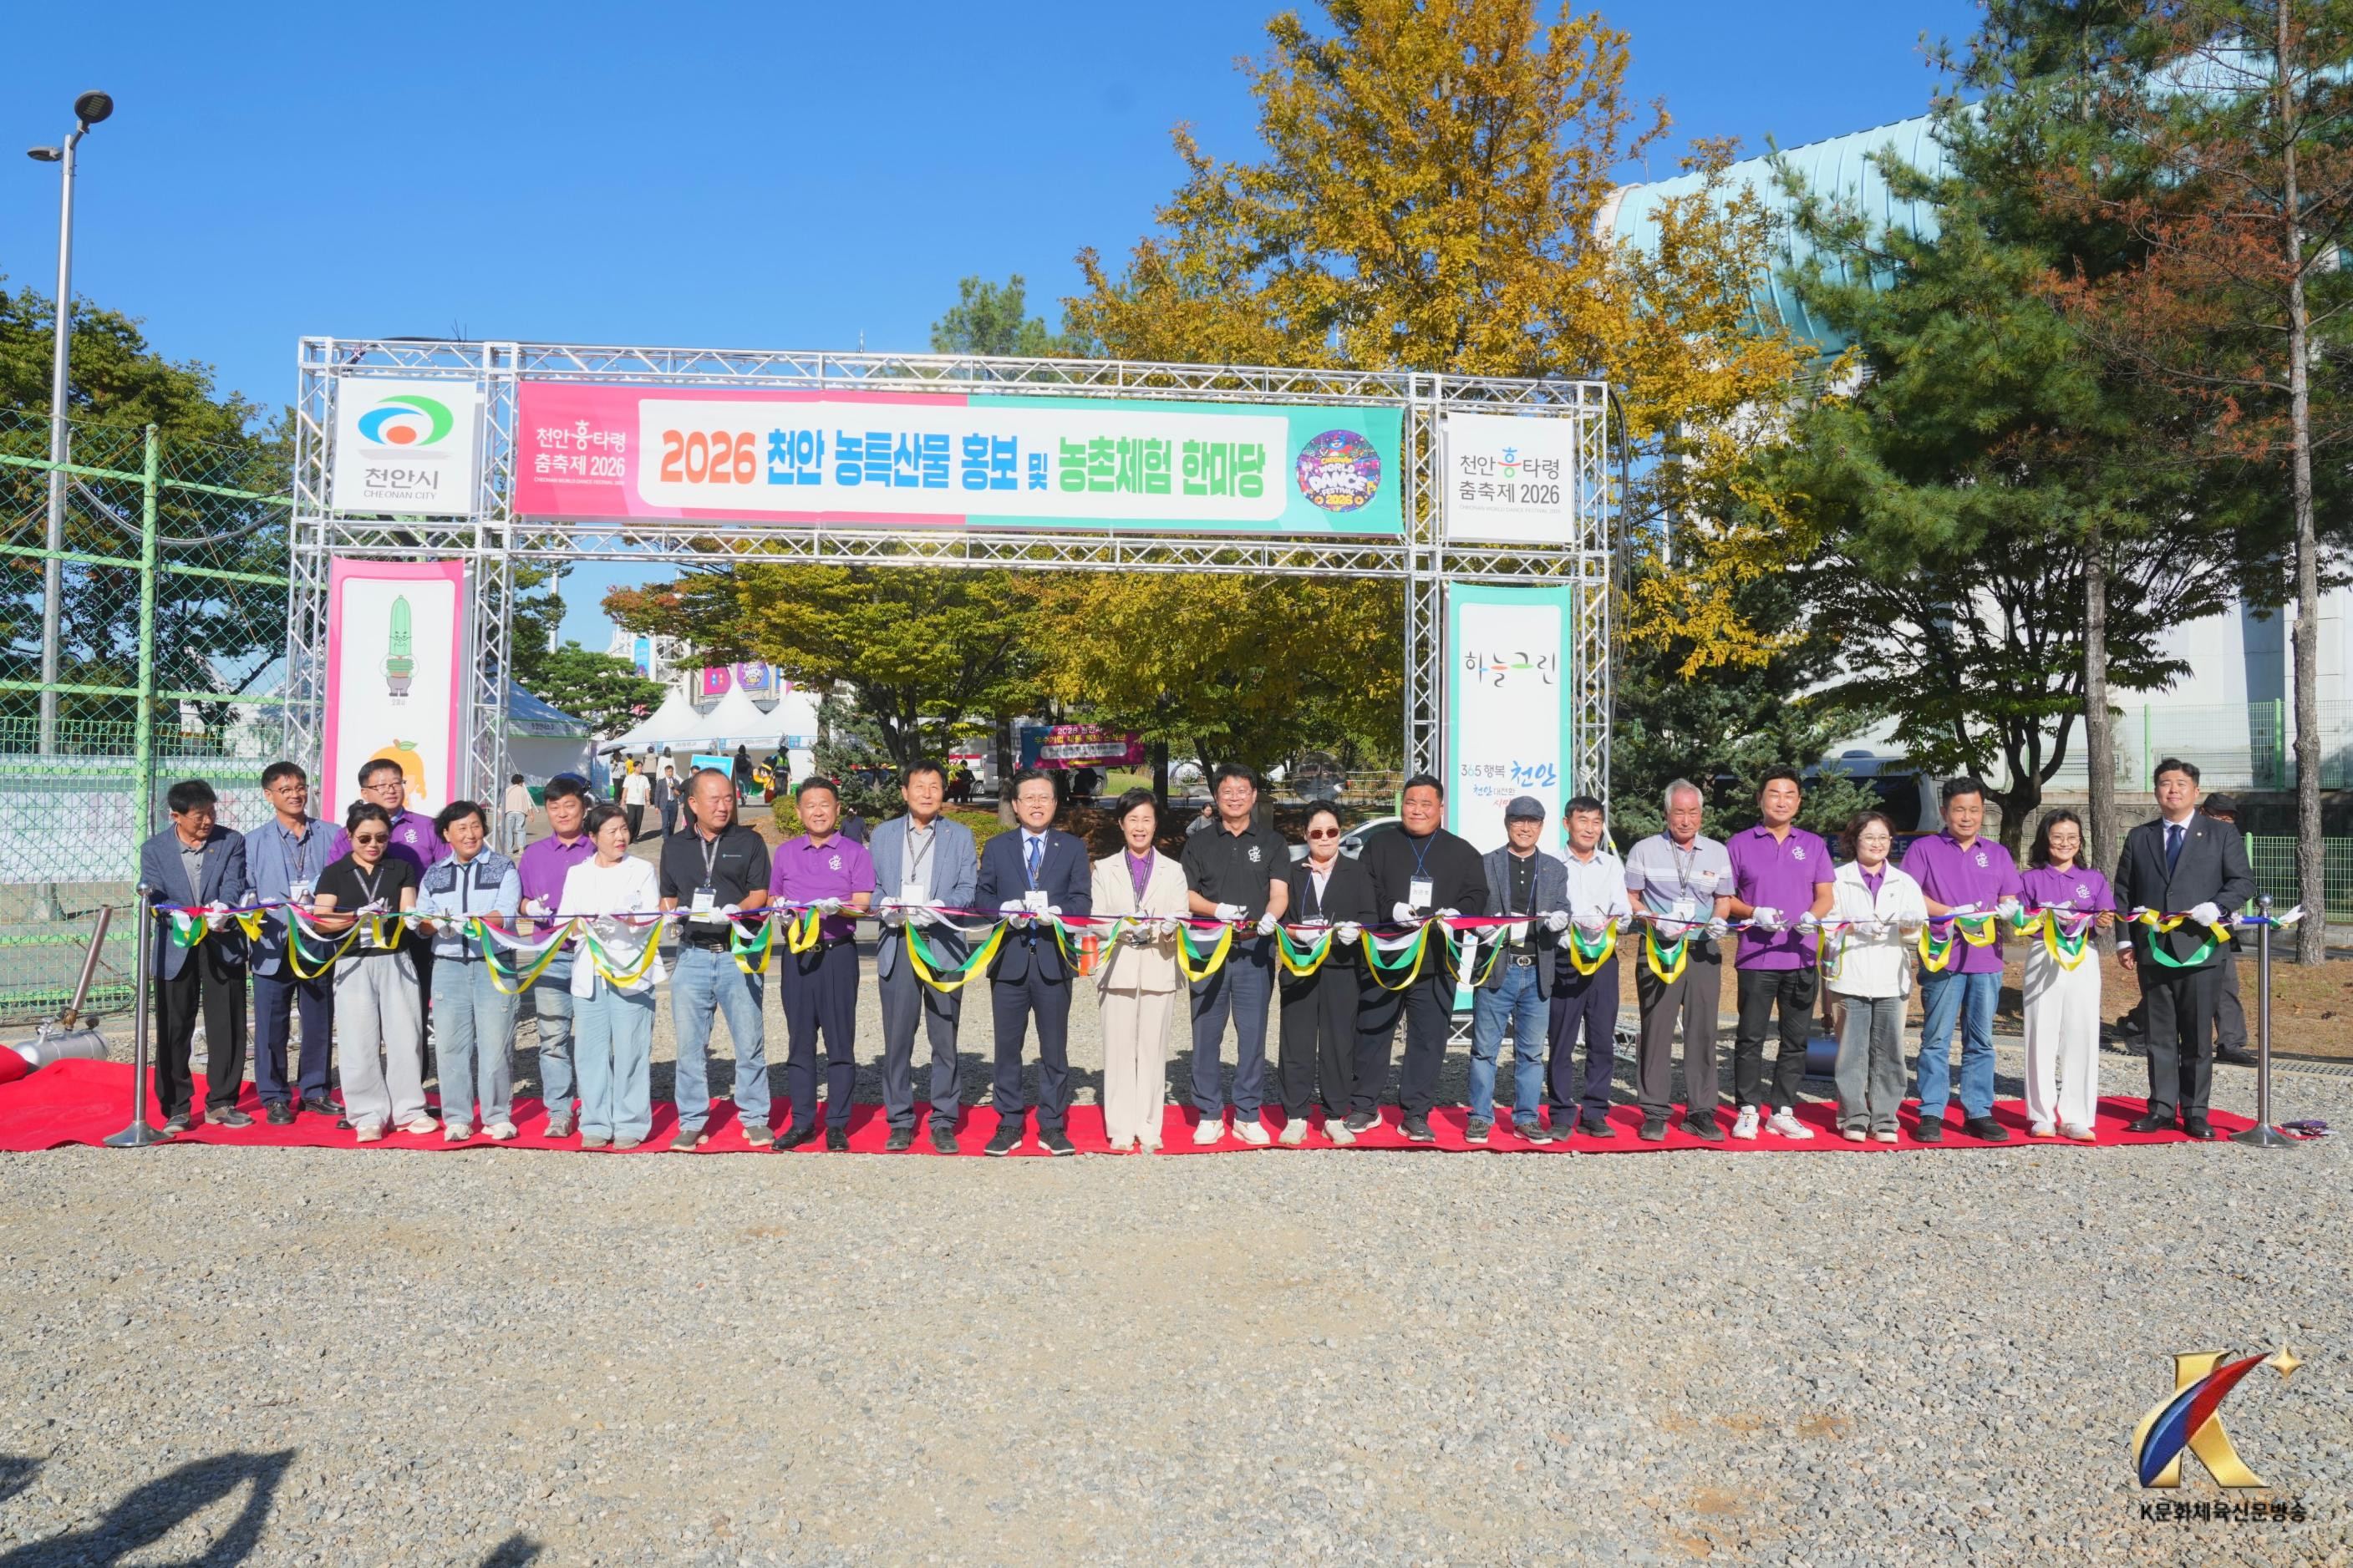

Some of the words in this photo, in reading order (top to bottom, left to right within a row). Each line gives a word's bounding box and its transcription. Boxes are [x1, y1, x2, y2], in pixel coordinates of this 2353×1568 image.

[536, 419, 626, 453] 천안흥타령
[534, 453, 587, 475] 춤축제
[590, 455, 625, 477] 2026
[660, 429, 756, 485] 2026
[767, 429, 825, 485] 천안
[835, 429, 950, 489] 농특산물
[961, 433, 1018, 491] 홍보
[1028, 453, 1048, 490] 및
[1059, 435, 1171, 495] 농촌체험
[1182, 439, 1266, 498] 한마당
[1319, 463, 1355, 474] WORLD
[1460, 447, 1559, 480] 천안흥타령
[364, 468, 439, 490] 천안시
[1309, 471, 1368, 493] DANCE
[363, 490, 413, 500] CHEONAN
[414, 491, 436, 500] CITY
[1320, 487, 1355, 496] FESTIVAL
[1459, 480, 1515, 503] 춤축제
[1520, 484, 1560, 505] 2026
[1464, 651, 1557, 688] 하늘그린
[1461, 764, 1482, 777] 365
[1484, 764, 1506, 779] 행복
[1510, 760, 1558, 788] 천안
